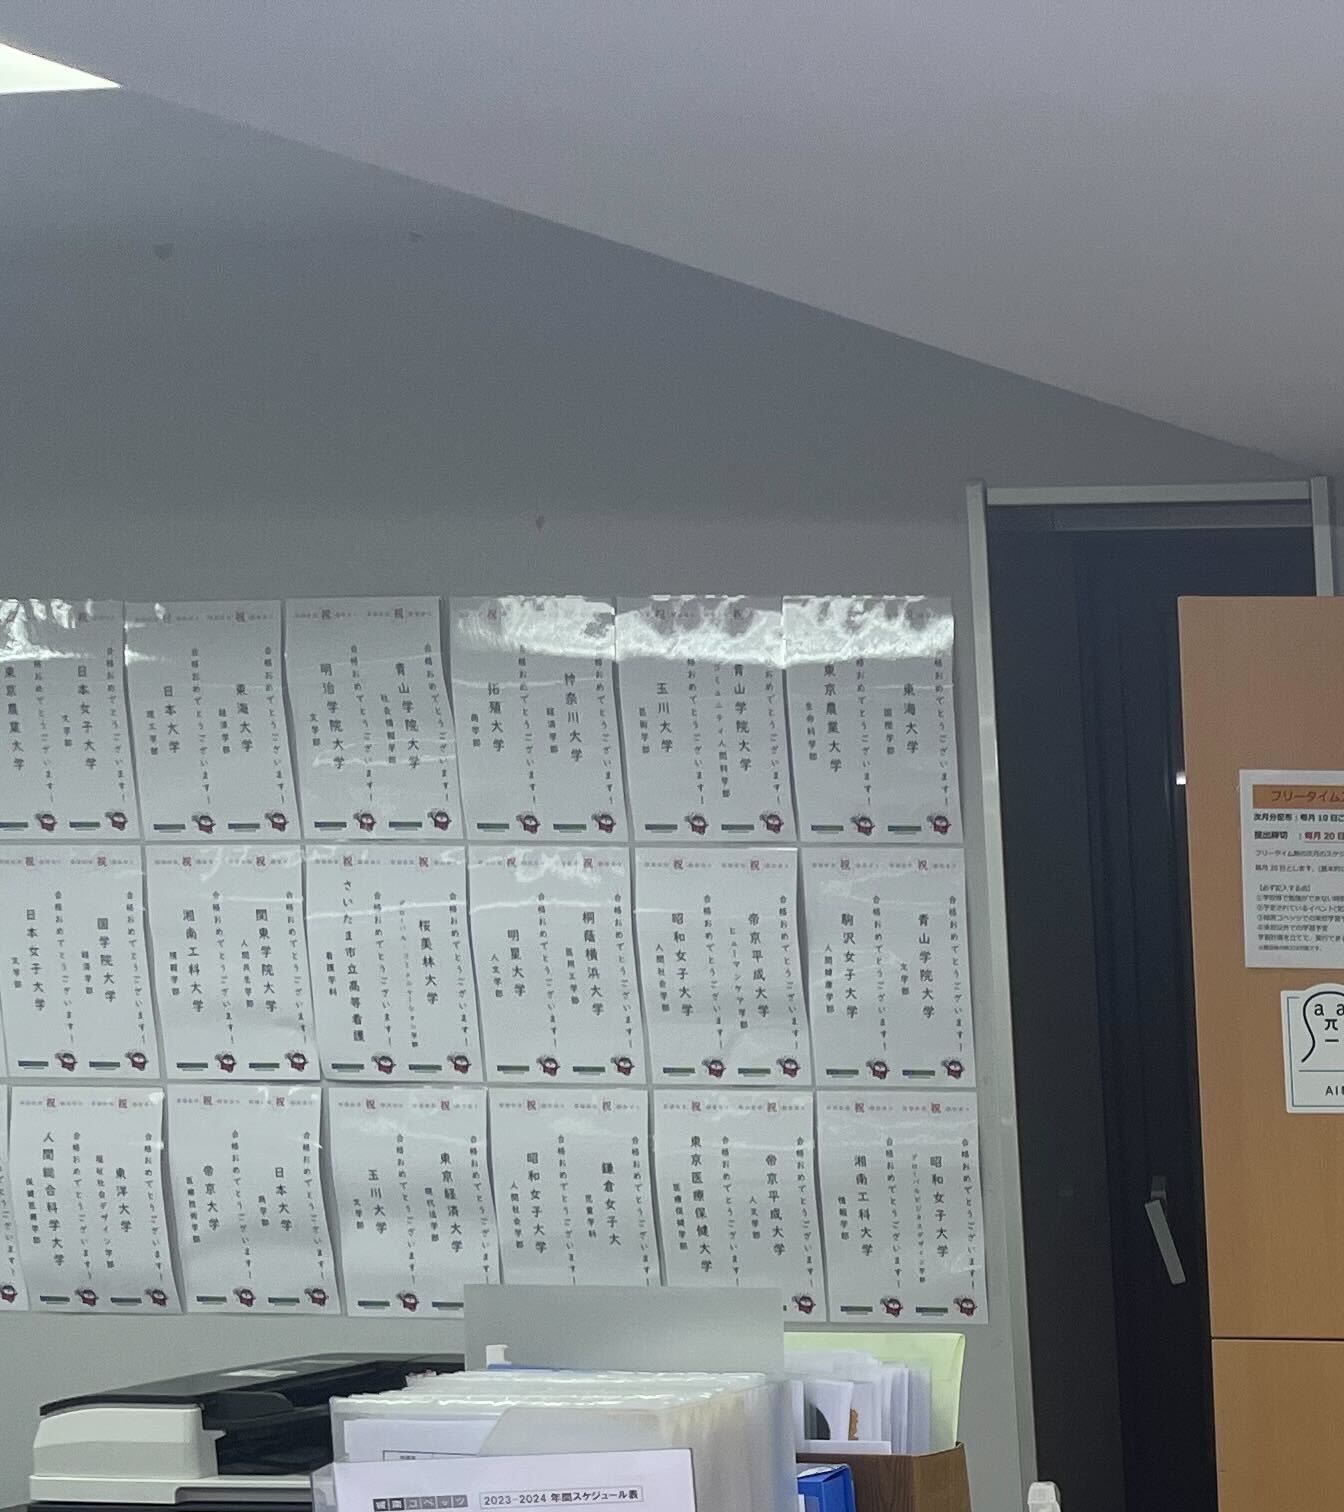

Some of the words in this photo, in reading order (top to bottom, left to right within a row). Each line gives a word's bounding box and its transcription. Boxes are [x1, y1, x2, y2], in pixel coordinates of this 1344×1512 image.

[78, 665, 96, 769] 日本女子大学
[163, 685, 180, 752] 日本大学
[236, 683, 253, 752] 東海大学
[321, 663, 344, 769] 明治学院大学
[395, 663, 420, 768] 青山学院大学
[488, 683, 505, 752] 拓殖大学
[564, 672, 583, 762] 神奈川大学
[657, 683, 673, 752] 玉川大学
[734, 665, 752, 772] 青山学院大学
[824, 665, 842, 772] 東京農業大学
[903, 684, 919, 753] 東海大学
[26, 910, 46, 1011] 日本女子大学
[183, 910, 204, 1012] 湘南工科大学
[256, 910, 276, 1012] 関東学院大学
[344, 880, 364, 1042] さいたま市立高等看護
[419, 920, 438, 1003] 桜美林大学
[507, 930, 525, 996] 明星大学
[583, 912, 603, 1015] 桐蔭横浜大学
[672, 913, 694, 1017] 昭和女子大学
[748, 913, 769, 1017] 帝京平成大学
[841, 914, 858, 1019] 駒沢女子大学
[918, 914, 935, 1019] 青山学院大学
[43, 1132, 65, 1267] 人間総合科学大学
[116, 1168, 132, 1232] 東洋大学
[203, 1166, 220, 1231] 帝京大学
[275, 1167, 292, 1231] 日本大学
[368, 1170, 387, 1234] 玉川大学
[440, 1153, 463, 1253] 東京経済大学
[527, 1153, 547, 1254] 昭和女子大学
[602, 1163, 621, 1246] 鎌倉女子大
[690, 1136, 712, 1271] 東京医療保健大学
[766, 1155, 785, 1255] 帝京平成大学
[854, 1155, 873, 1256] 湘南工科大学
[930, 1156, 948, 1257] 昭和女子大学
[550, 1489, 639, 1503] 年間スケジュール表
